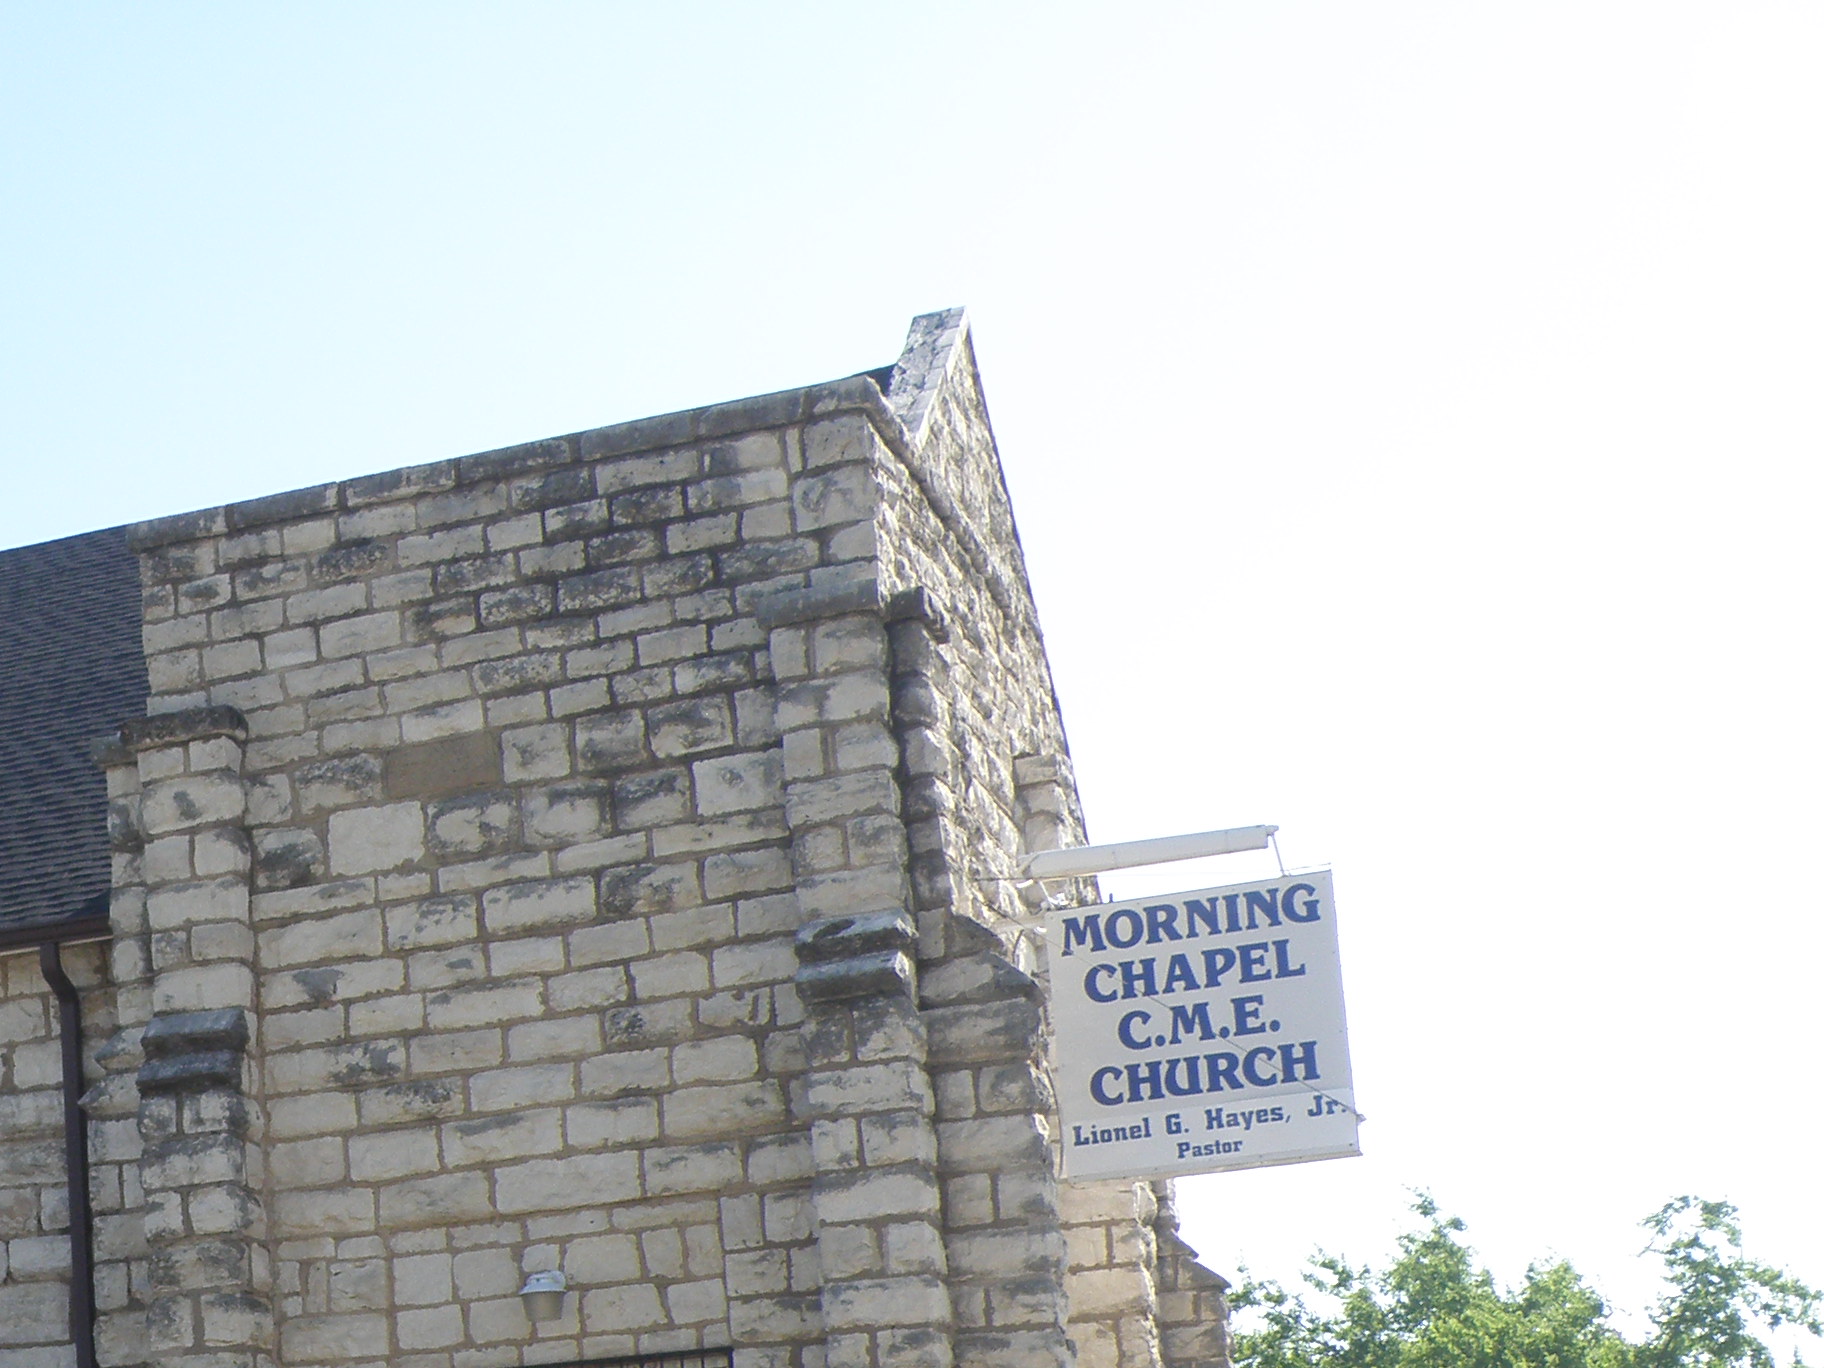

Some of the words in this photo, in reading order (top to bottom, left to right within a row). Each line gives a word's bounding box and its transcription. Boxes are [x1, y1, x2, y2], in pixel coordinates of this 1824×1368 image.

[1061, 883, 1321, 957] MORNING
[1084, 939, 1306, 1003] CHAPEL
[1118, 995, 1281, 1051] C.M.E.
[1090, 1040, 1321, 1106] CHURCH
[1073, 1117, 1152, 1147] Lionel
[1165, 1113, 1190, 1135] G.
[1204, 1107, 1291, 1131] Hayes,
[1307, 1095, 1347, 1118] Jr.
[1177, 1139, 1243, 1159] Pastor
